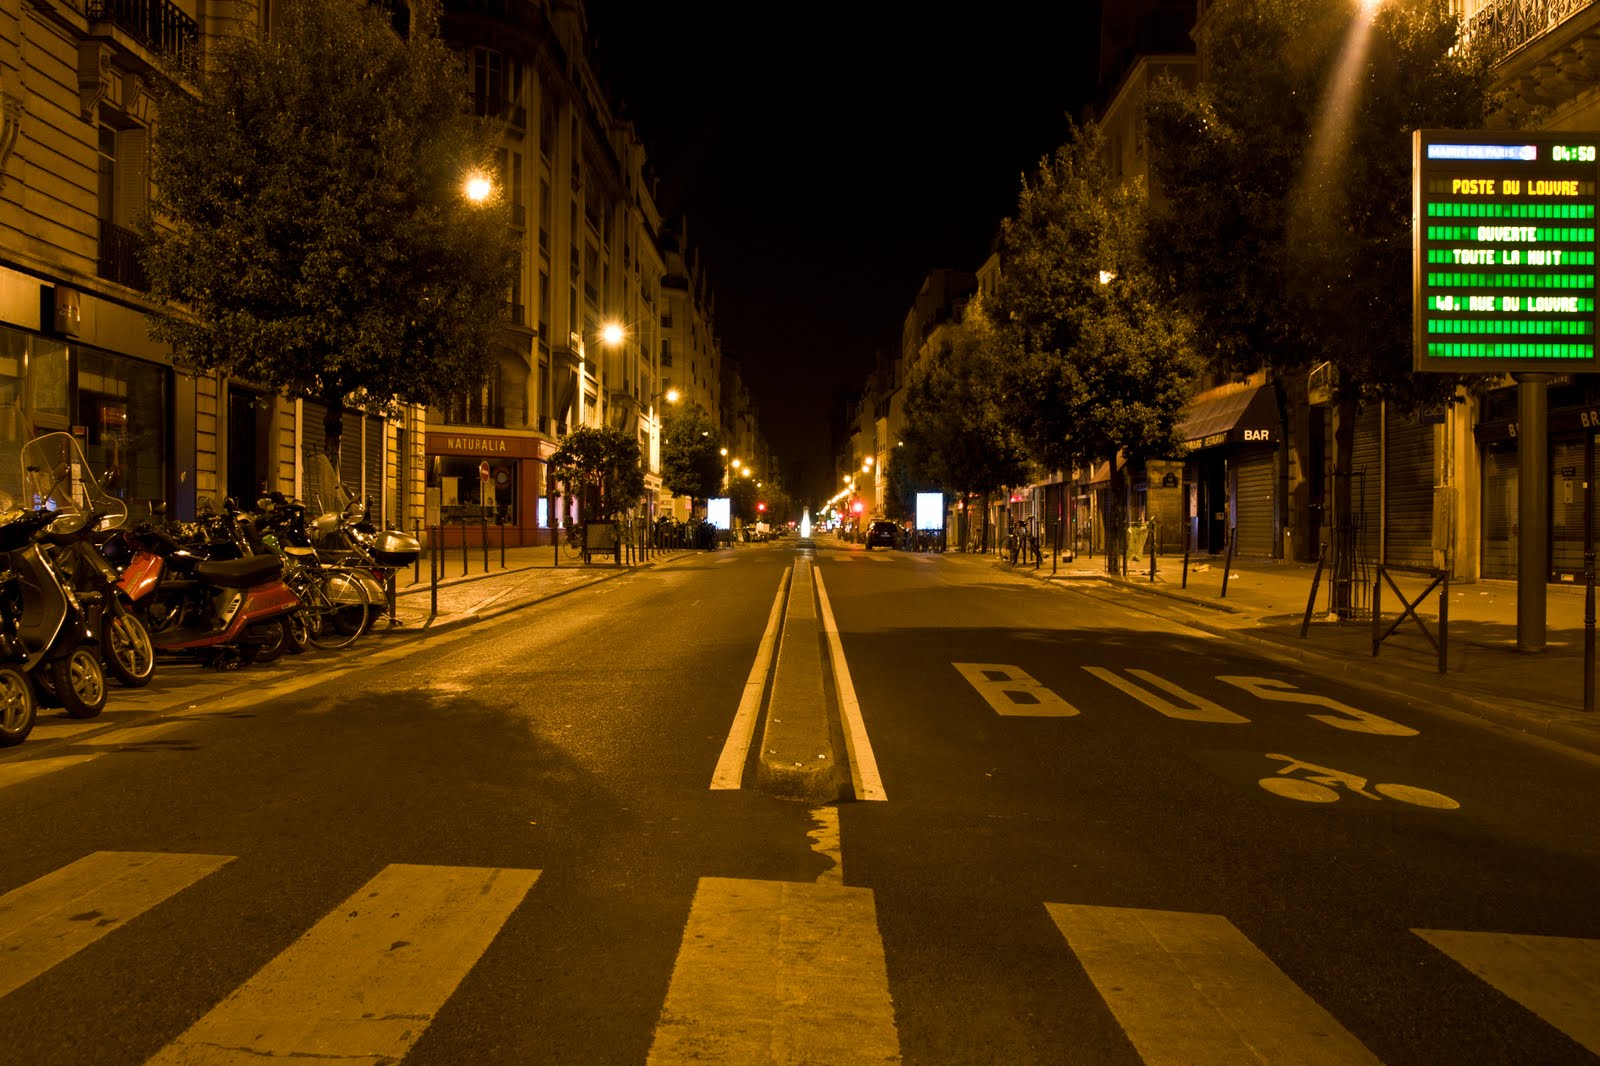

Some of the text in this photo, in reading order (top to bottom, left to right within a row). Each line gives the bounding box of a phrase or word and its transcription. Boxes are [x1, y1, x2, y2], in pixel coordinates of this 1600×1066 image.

[1429, 147, 1515, 158] MAIRIE DE PARIS
[1552, 145, 1596, 161] 04:50
[1453, 179, 1579, 196] POSTE DU LOUVRE
[1477, 226, 1537, 242] OUVERTE
[1453, 249, 1562, 266] TOUTE LA NUIT
[1469, 296, 1495, 312] RUE
[1502, 297, 1520, 312] DU
[1527, 297, 1579, 313] LOUVRE
[1244, 429, 1270, 441] BAR
[447, 437, 506, 452] NATURALIA
[950, 661, 1421, 737] BUS
